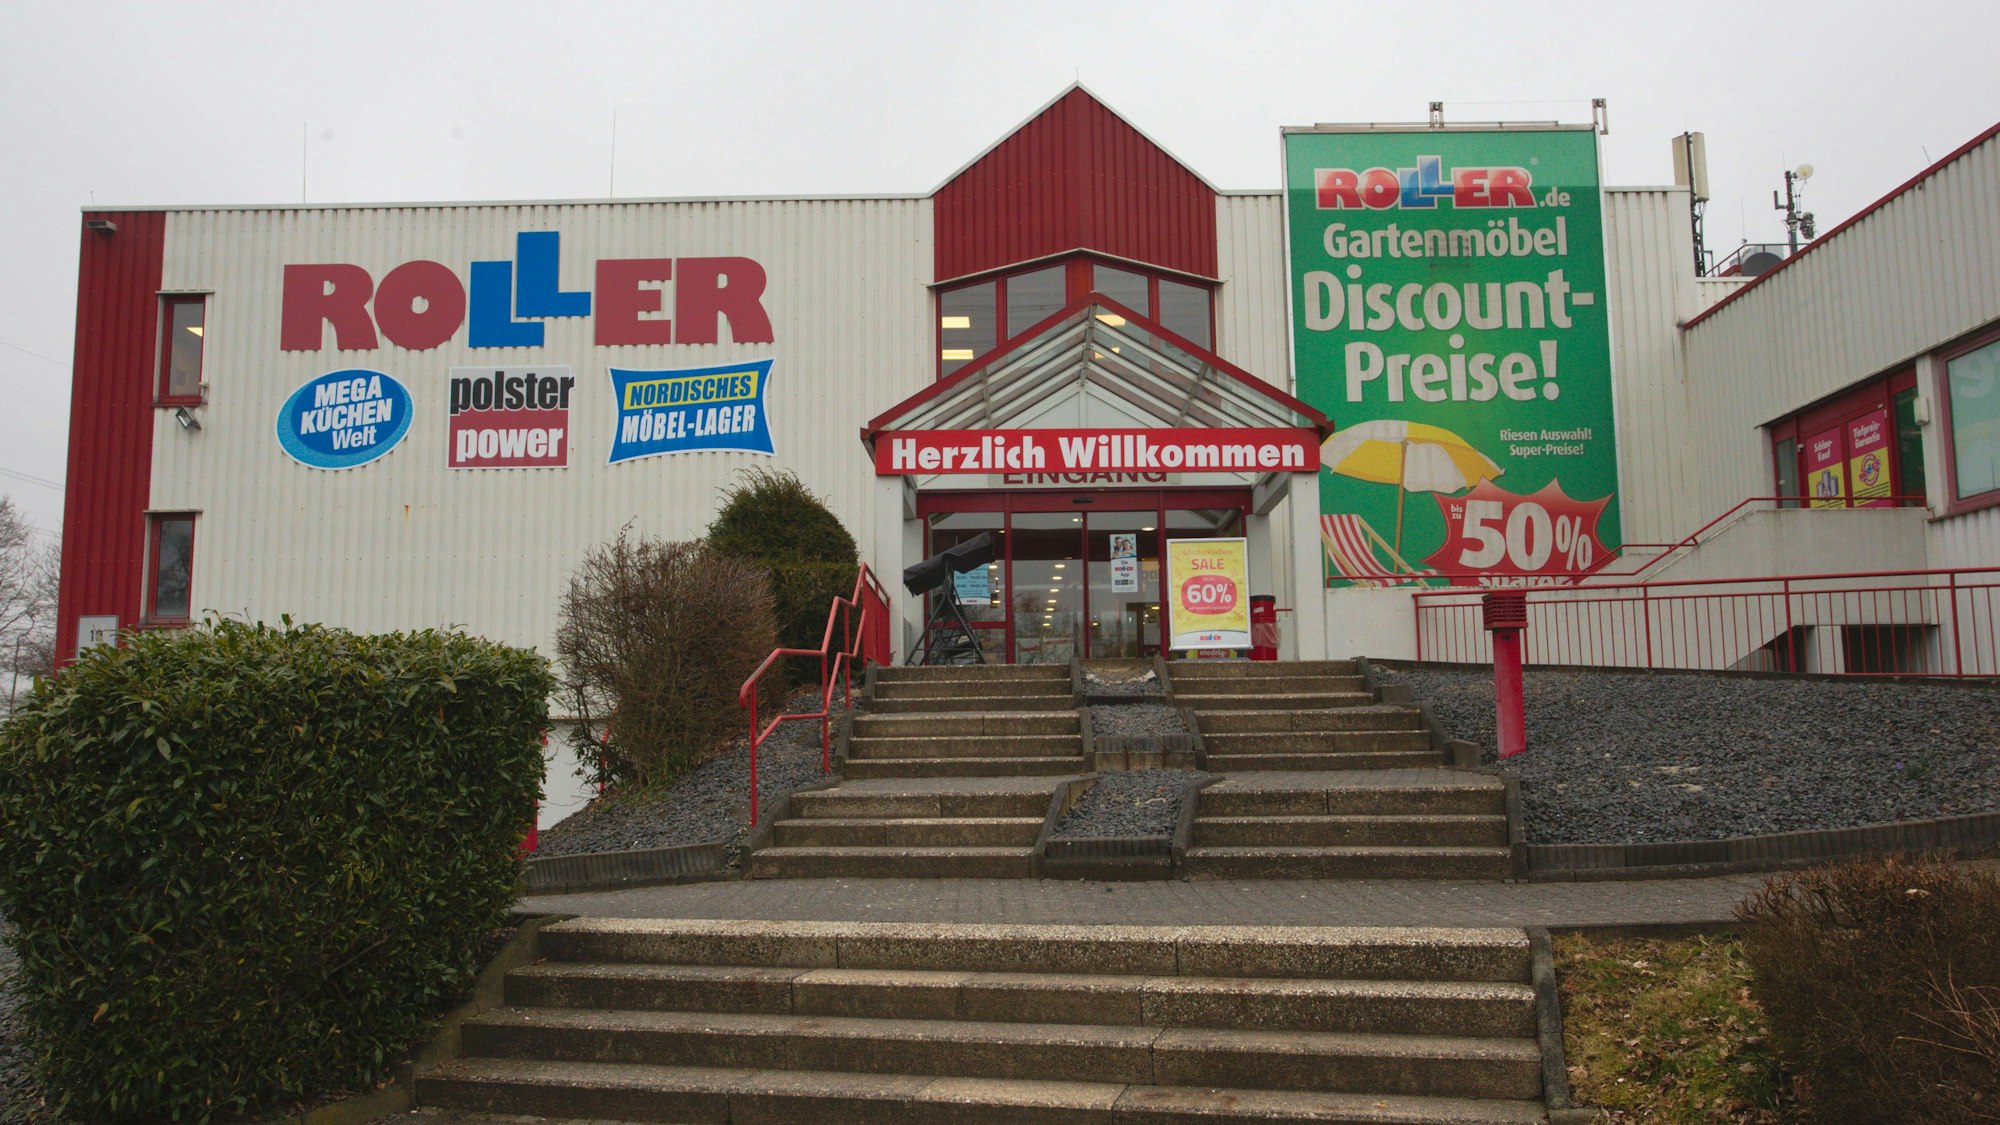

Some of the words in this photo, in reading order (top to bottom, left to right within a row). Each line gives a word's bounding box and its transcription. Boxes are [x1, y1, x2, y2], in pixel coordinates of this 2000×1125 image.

[1324, 216, 1567, 258] Gartenmöbel
[280, 231, 775, 351] ROLLER
[1304, 264, 1594, 331] Discount-
[1345, 334, 1560, 402] Preise!
[314, 375, 382, 408] MEGA
[450, 371, 574, 414] polster
[630, 375, 751, 406] NORDISCHES
[300, 398, 392, 435] KÜCHEN
[621, 404, 756, 443] MÖBEL-LAGER
[1500, 429, 1538, 441] Riesen
[1540, 427, 1592, 440] Auswahl!
[332, 425, 377, 450] Welt
[456, 428, 563, 462] power
[892, 436, 1046, 470] Herzlich
[1060, 435, 1304, 469] Willkommen
[1509, 443, 1584, 458] Super-Preise!
[1451, 504, 1463, 513] bis
[1458, 500, 1593, 571] 50%
[1192, 558, 1224, 570] SALE
